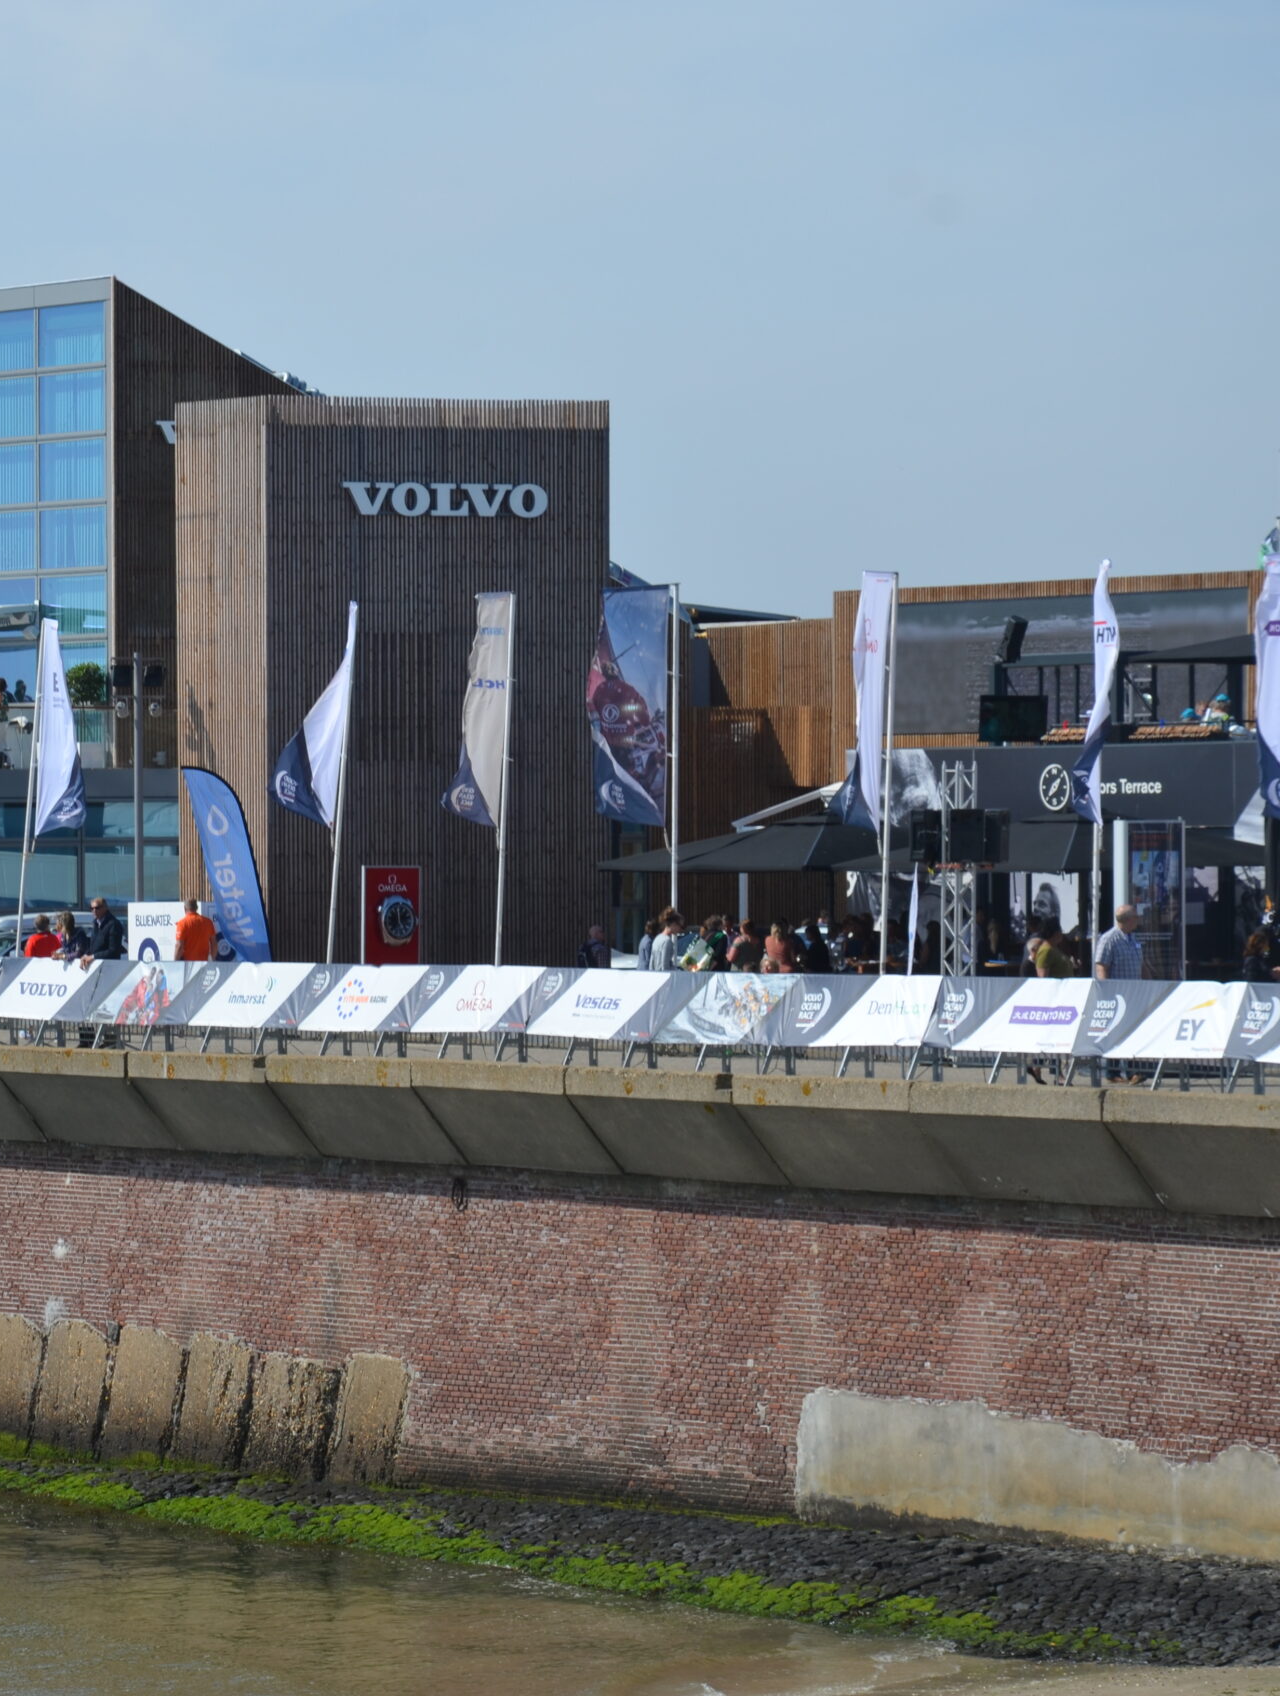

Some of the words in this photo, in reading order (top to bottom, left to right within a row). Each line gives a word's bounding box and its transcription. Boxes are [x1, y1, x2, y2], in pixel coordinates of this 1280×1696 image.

[342, 481, 549, 519] VOLVO
[1119, 778, 1162, 794] Terrace
[377, 884, 408, 892] OMEGA
[135, 914, 173, 927] BLUEWATER
[20, 982, 67, 997] VOLVO
[228, 992, 267, 1004] inmarsat
[575, 994, 622, 1010] Vestas
[804, 993, 823, 1002] VOLVO
[456, 999, 493, 1012] OMEGA
[801, 1002, 822, 1011] OCEAN
[1097, 1000, 1116, 1009] VOLVO
[1251, 1001, 1272, 1011] VOLVO
[798, 1011, 815, 1019] RACE
[1093, 1009, 1115, 1018] OCEAN
[1247, 1010, 1270, 1020] OCEAN
[1090, 1018, 1108, 1027] RACE
[1243, 1020, 1263, 1029] RACE
[1175, 1018, 1206, 1041] EY
